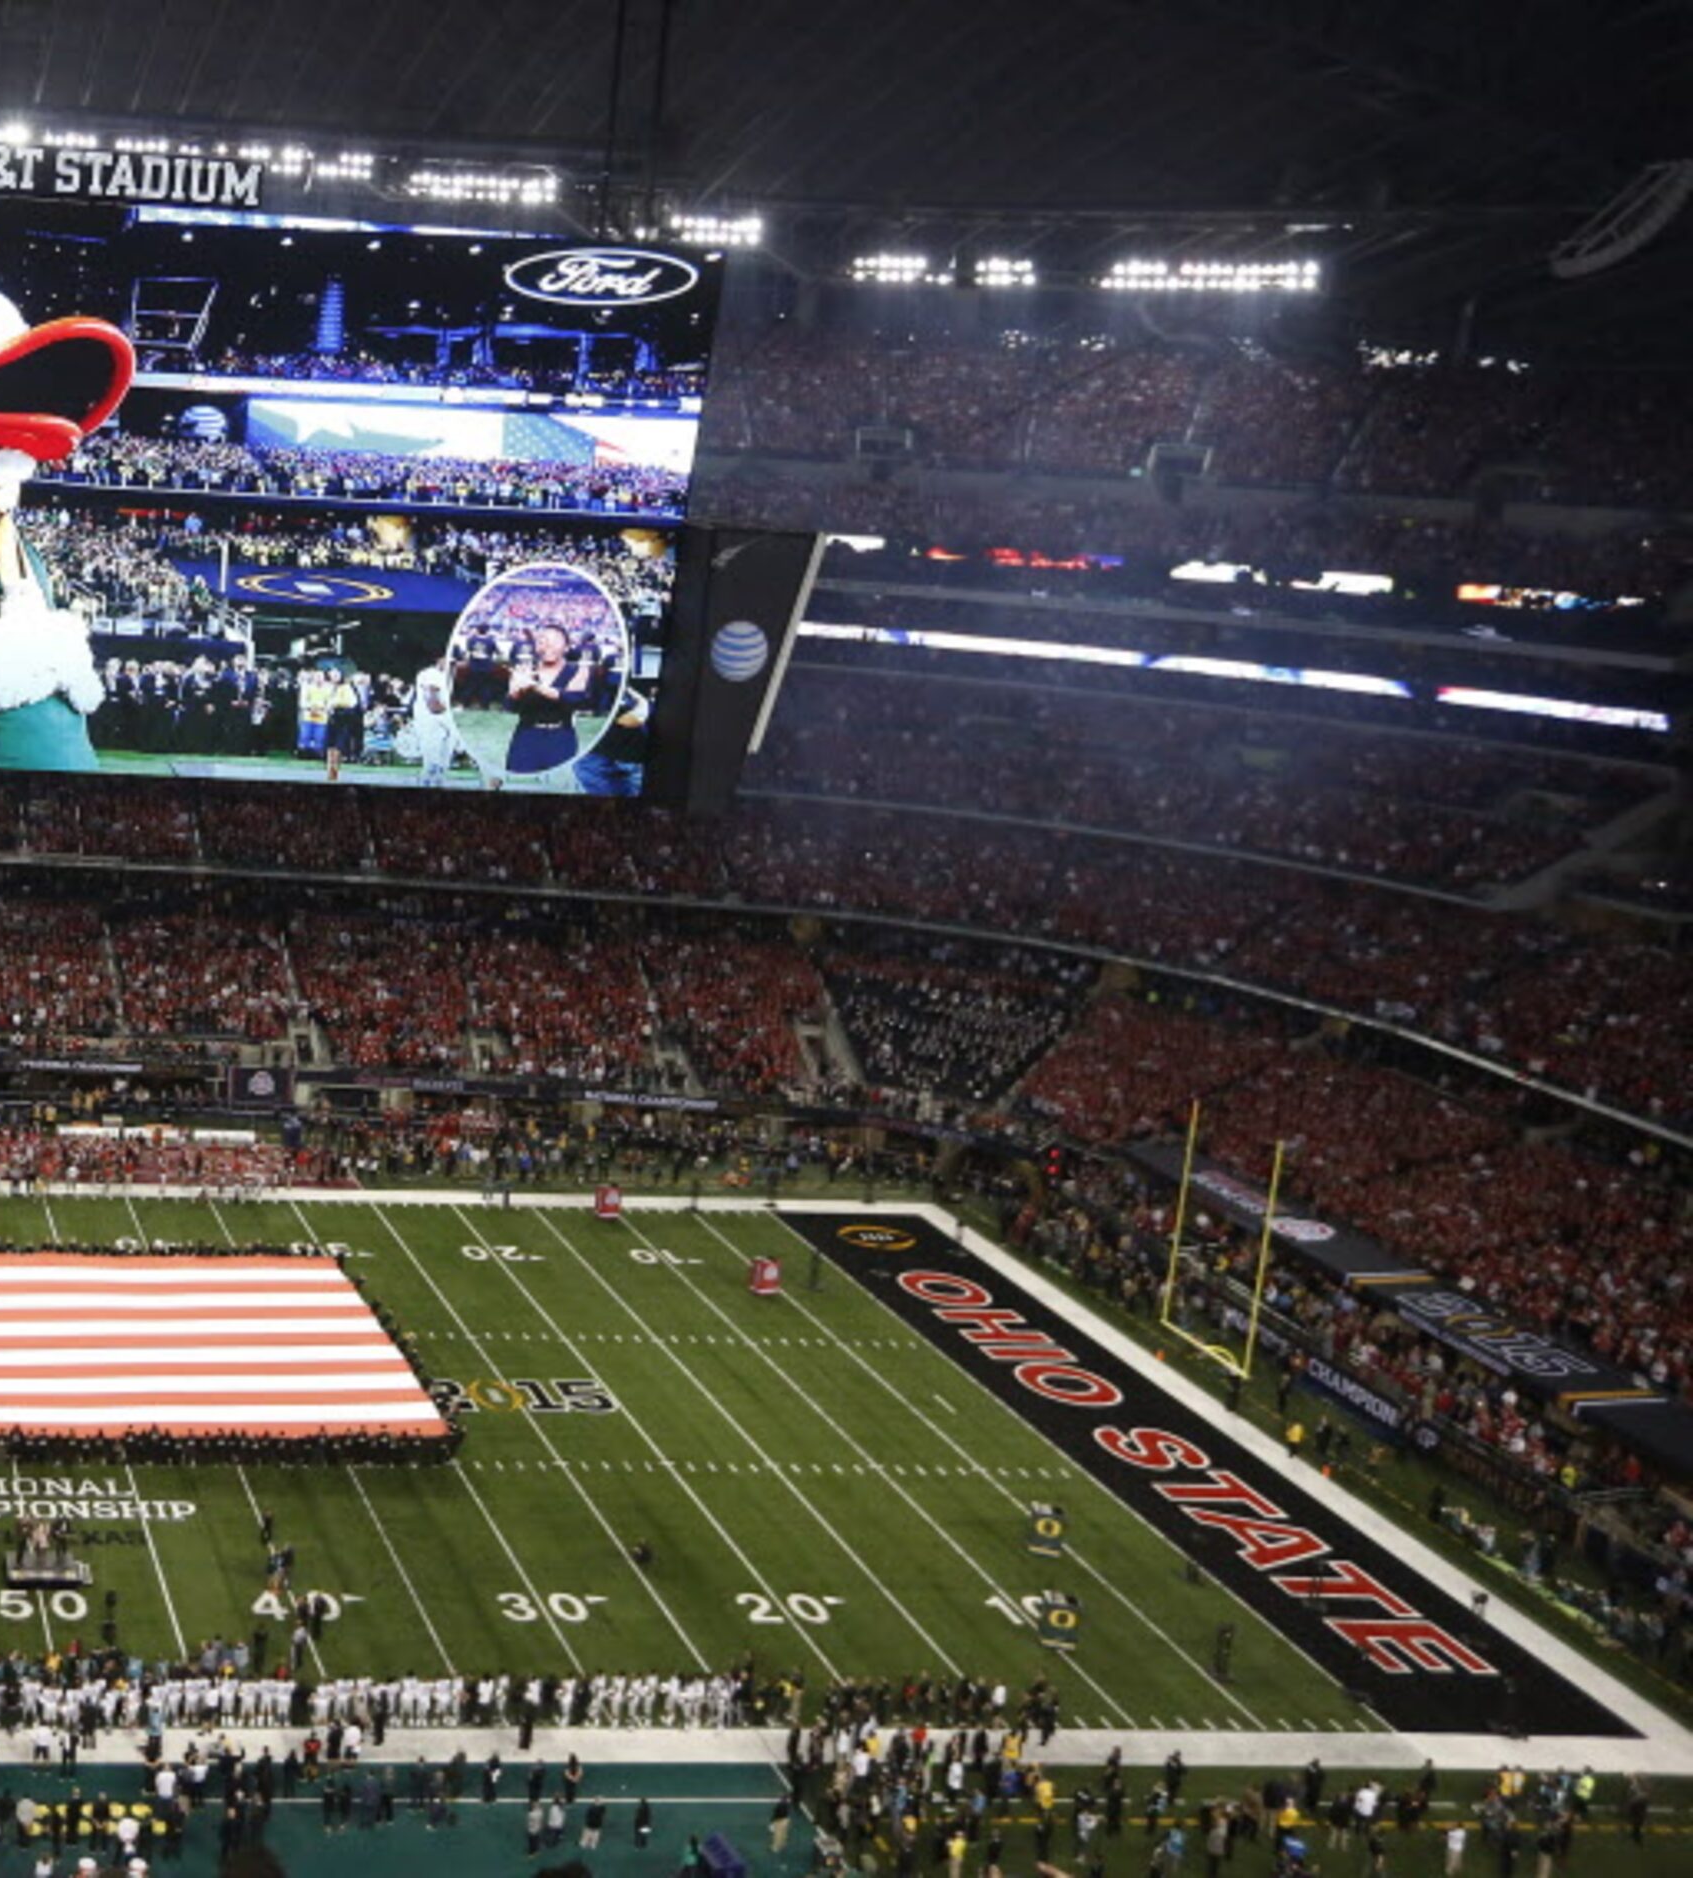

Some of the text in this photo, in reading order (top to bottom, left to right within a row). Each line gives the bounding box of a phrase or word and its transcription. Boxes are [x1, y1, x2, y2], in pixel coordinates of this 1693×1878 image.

[55, 151, 263, 206] STADIUM
[538, 256, 662, 296] Ford
[461, 1245, 526, 1261] 20
[629, 1249, 683, 1265] 10
[896, 1270, 1501, 1676] OHIO STATE
[496, 1592, 591, 1624] 30
[736, 1592, 832, 1625] 20
